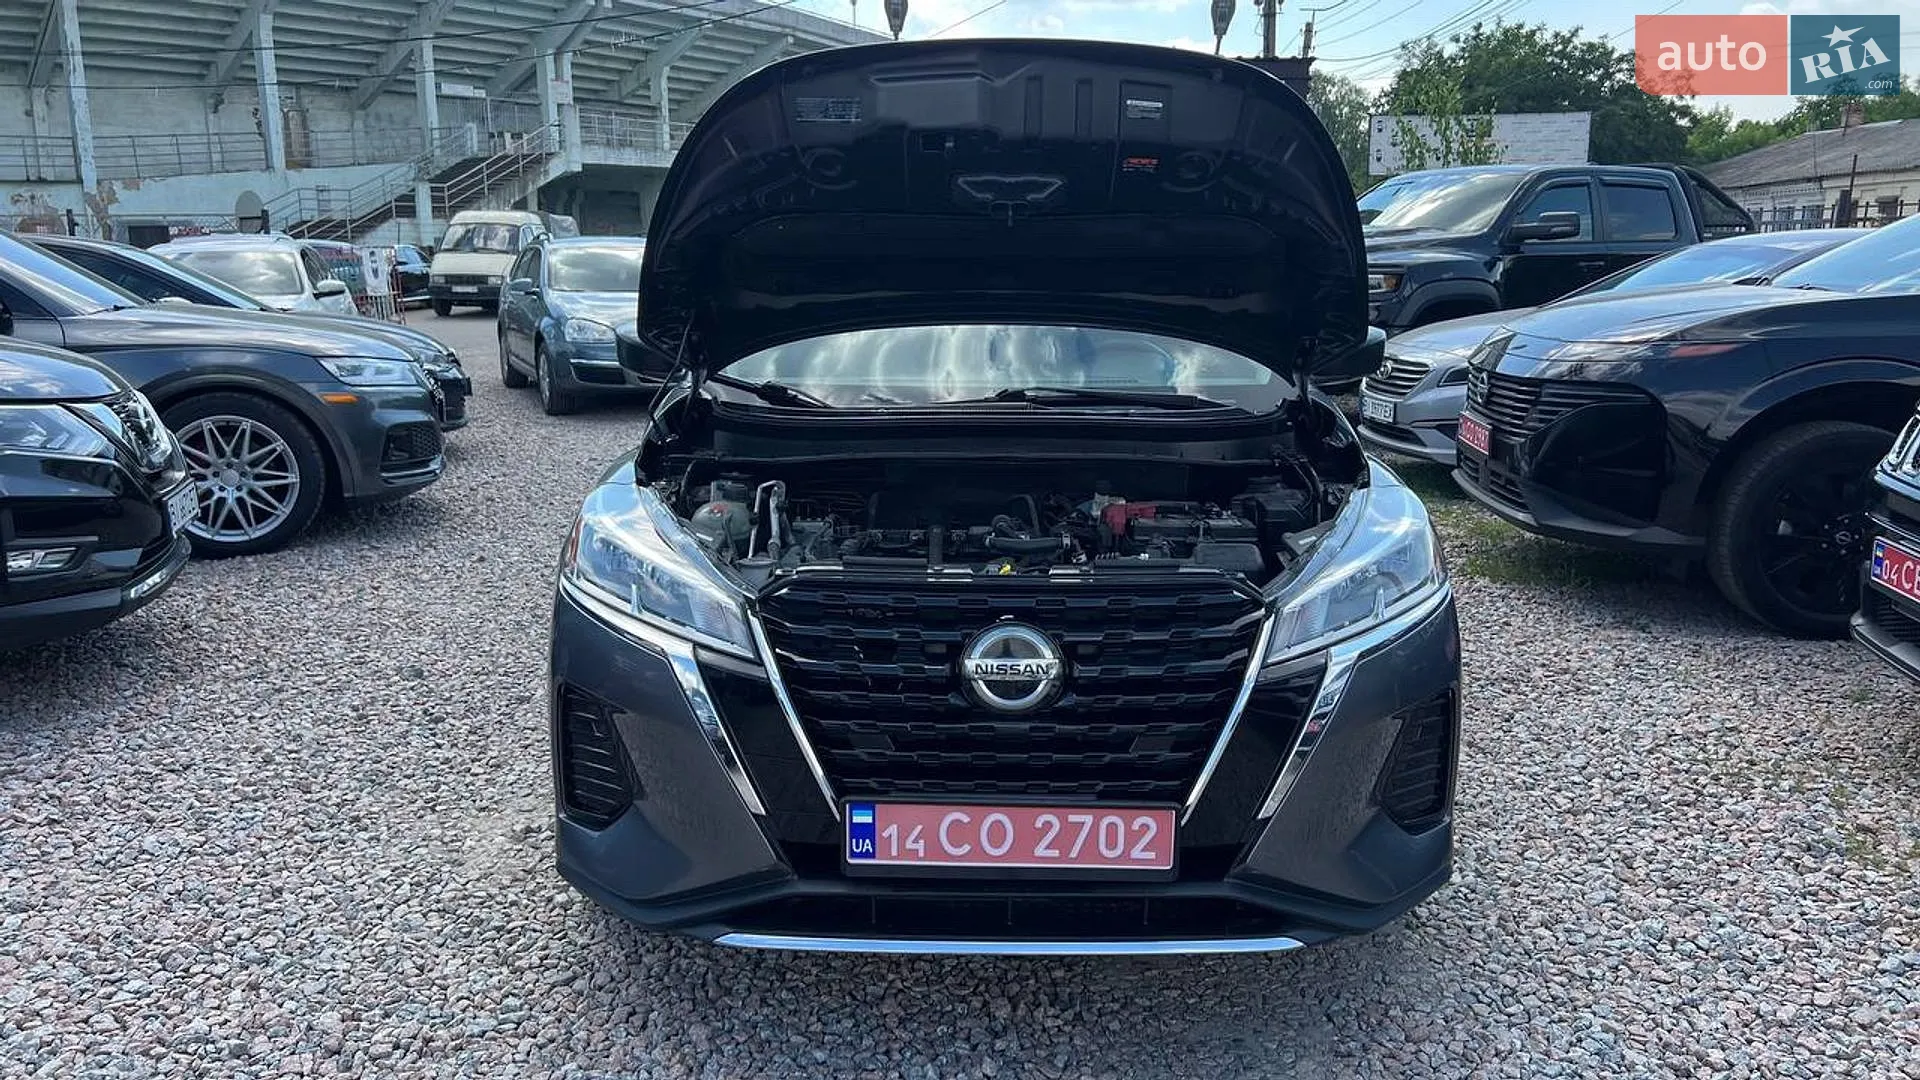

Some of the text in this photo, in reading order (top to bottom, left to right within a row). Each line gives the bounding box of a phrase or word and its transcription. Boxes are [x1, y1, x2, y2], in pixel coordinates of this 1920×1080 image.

[1882, 559, 1899, 585] 04
[974, 663, 1049, 675] NISSAN
[852, 838, 873, 854] UA
[882, 811, 1158, 860] 14 CO 2702
